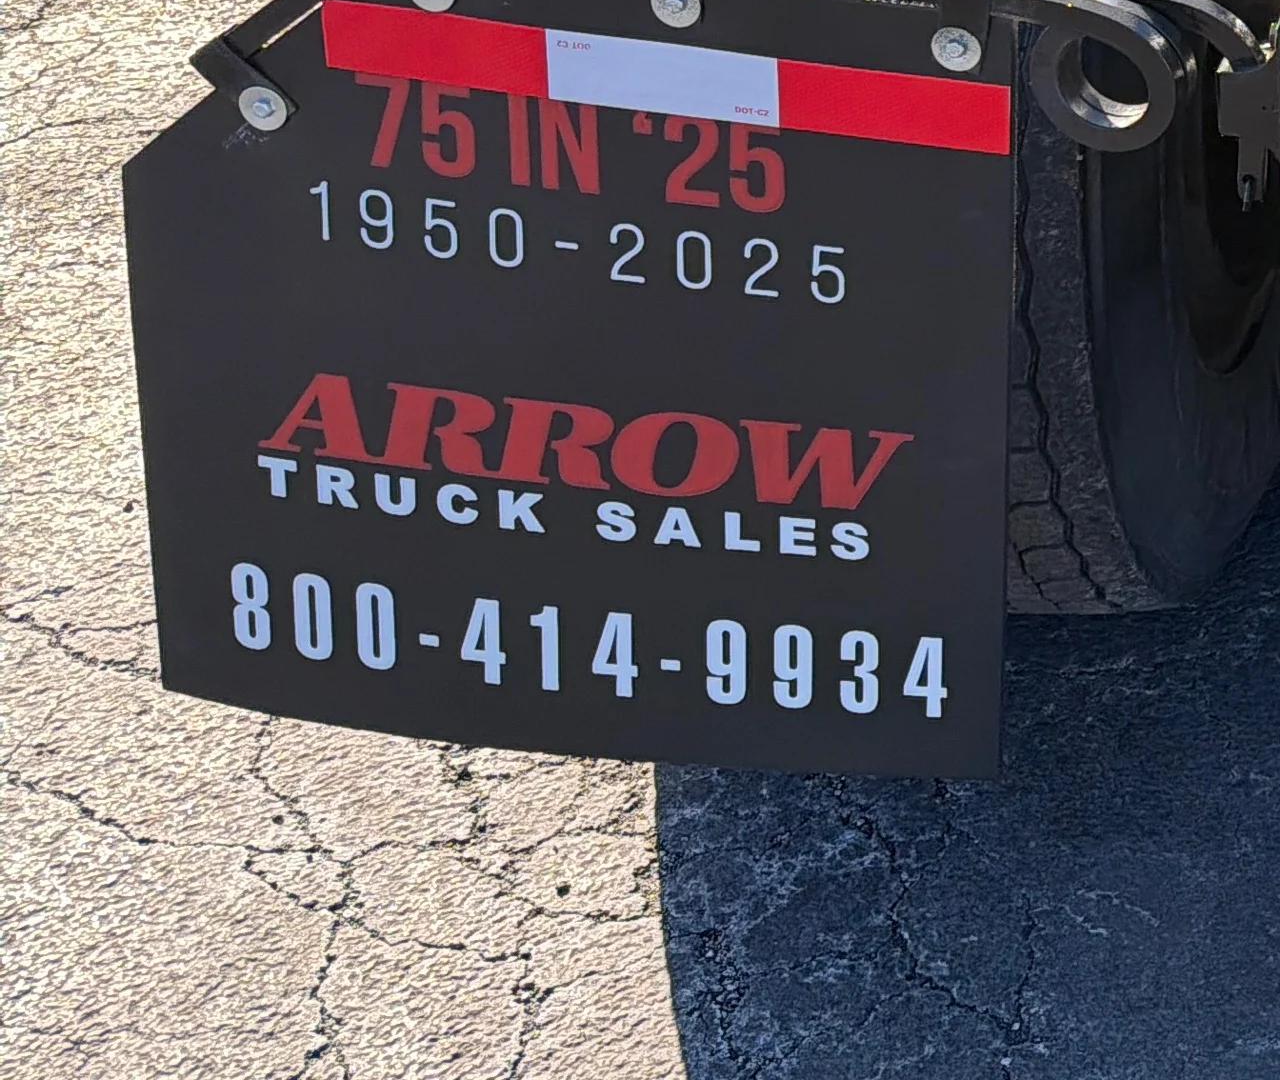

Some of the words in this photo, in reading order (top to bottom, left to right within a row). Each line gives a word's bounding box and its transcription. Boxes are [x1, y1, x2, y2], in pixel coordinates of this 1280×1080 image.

[354, 70, 476, 179] 75
[507, 93, 601, 196] IN
[735, 106, 769, 117] DOT-C2
[309, 180, 847, 304] 1950-2025
[257, 373, 915, 511] ARROW
[257, 454, 546, 534] TRUCK
[596, 500, 871, 562] SALES
[230, 562, 948, 718] 800-414-9934
